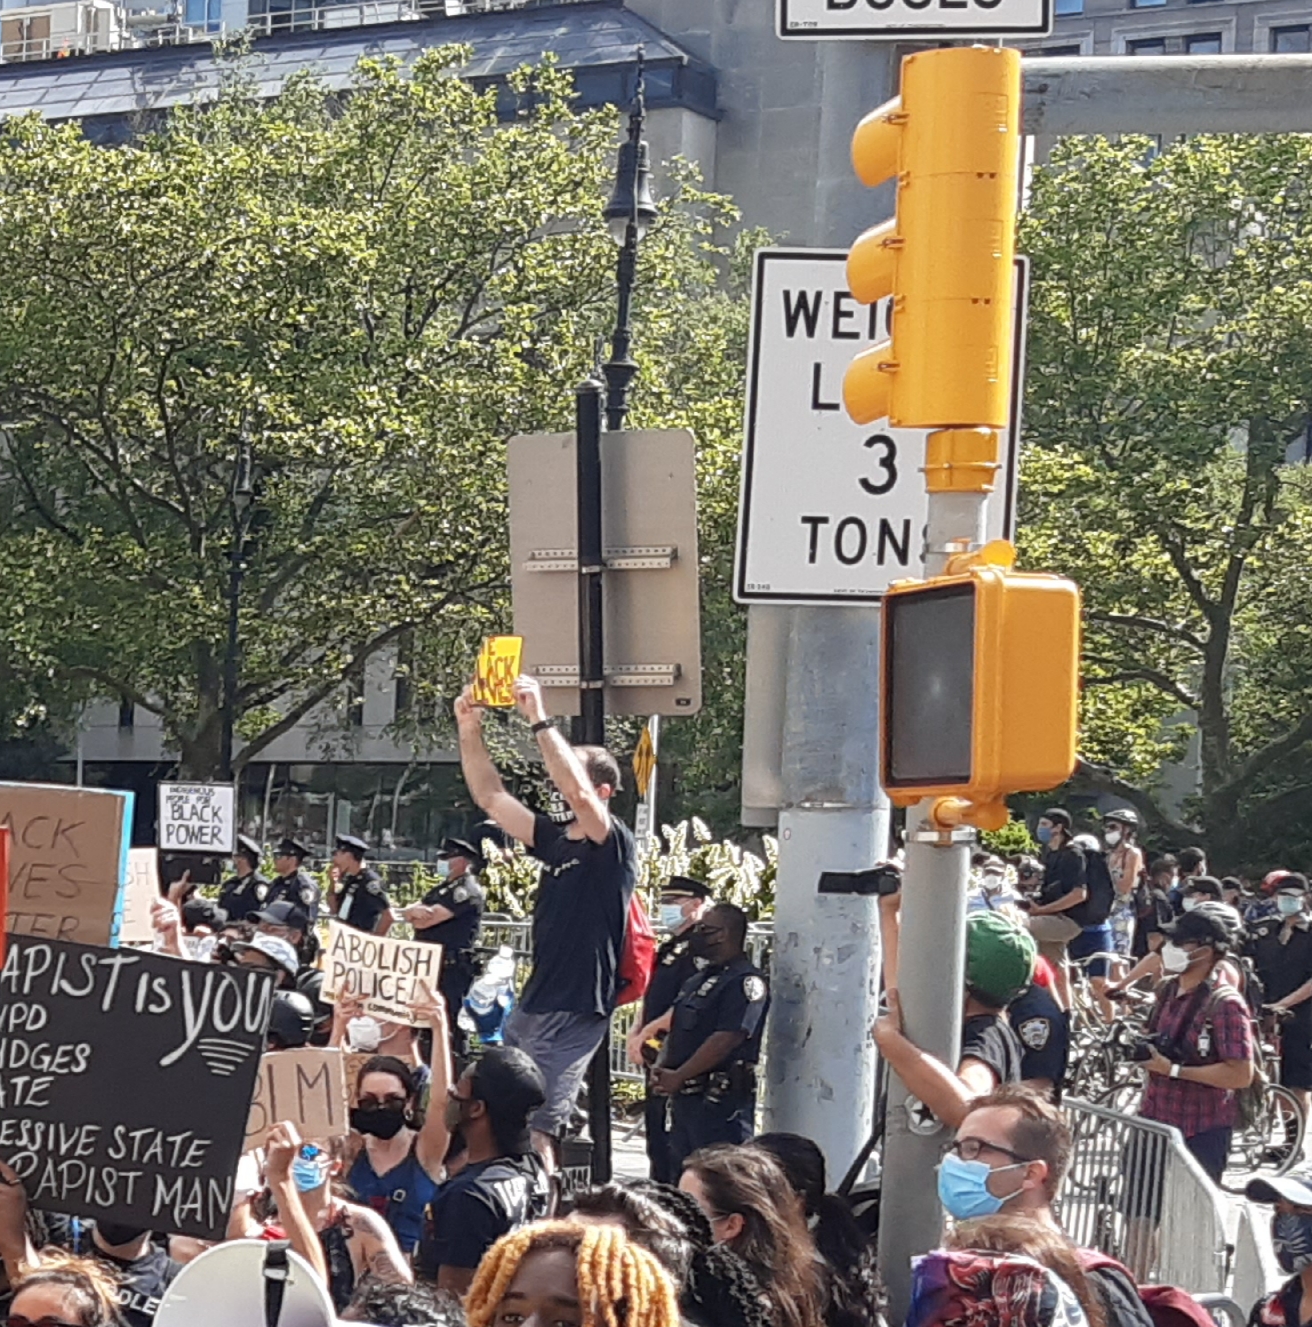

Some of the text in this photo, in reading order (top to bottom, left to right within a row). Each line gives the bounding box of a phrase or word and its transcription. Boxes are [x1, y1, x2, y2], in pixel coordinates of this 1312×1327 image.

[782, 289, 893, 341] WEI
[857, 434, 897, 496] 3
[801, 516, 928, 568] TON
[166, 823, 224, 845] POWER
[171, 804, 223, 824] BLACK
[1, 943, 140, 1012] APIST
[332, 931, 433, 977] ABOLISH
[108, 1125, 212, 1168] STATE
[152, 1174, 232, 1229] MAN
